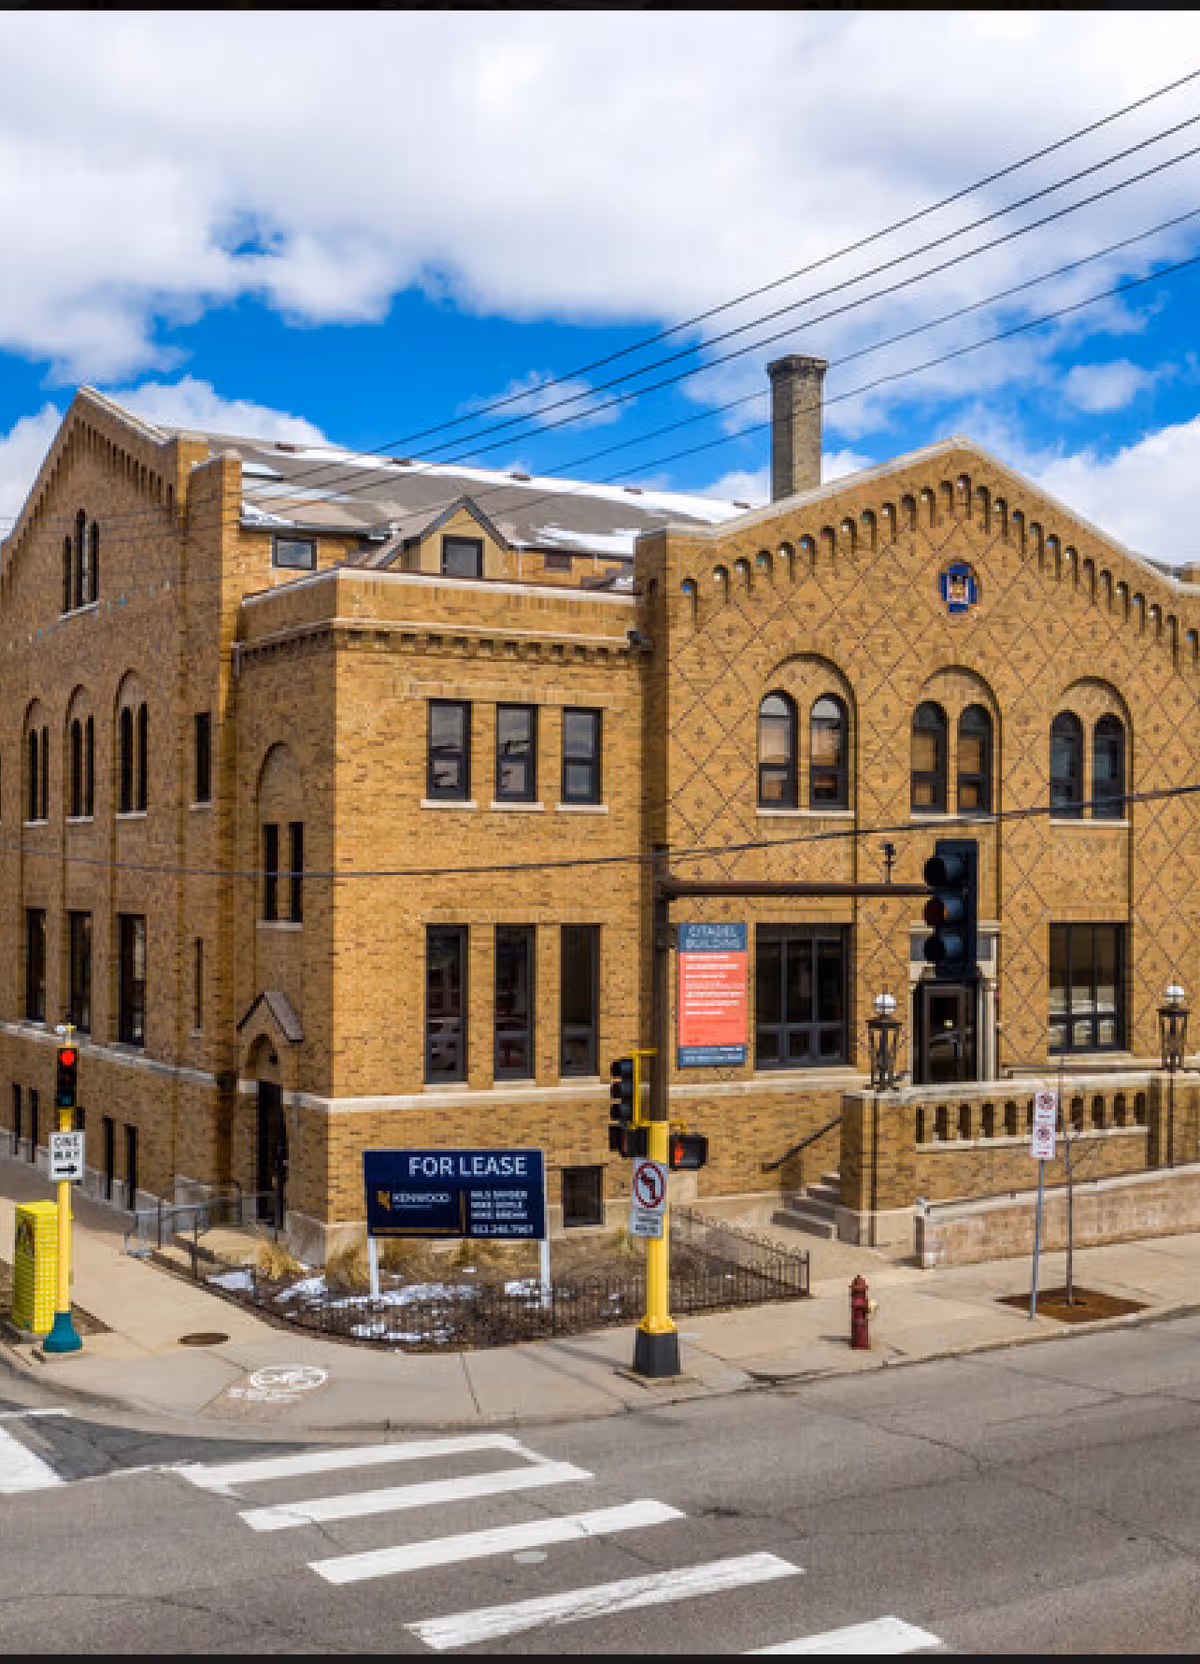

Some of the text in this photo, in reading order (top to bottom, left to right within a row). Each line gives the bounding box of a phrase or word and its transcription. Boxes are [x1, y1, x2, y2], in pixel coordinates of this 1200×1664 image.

[409, 1156, 528, 1177] FOR LEASE
[392, 1193, 450, 1203] KENWOOD
